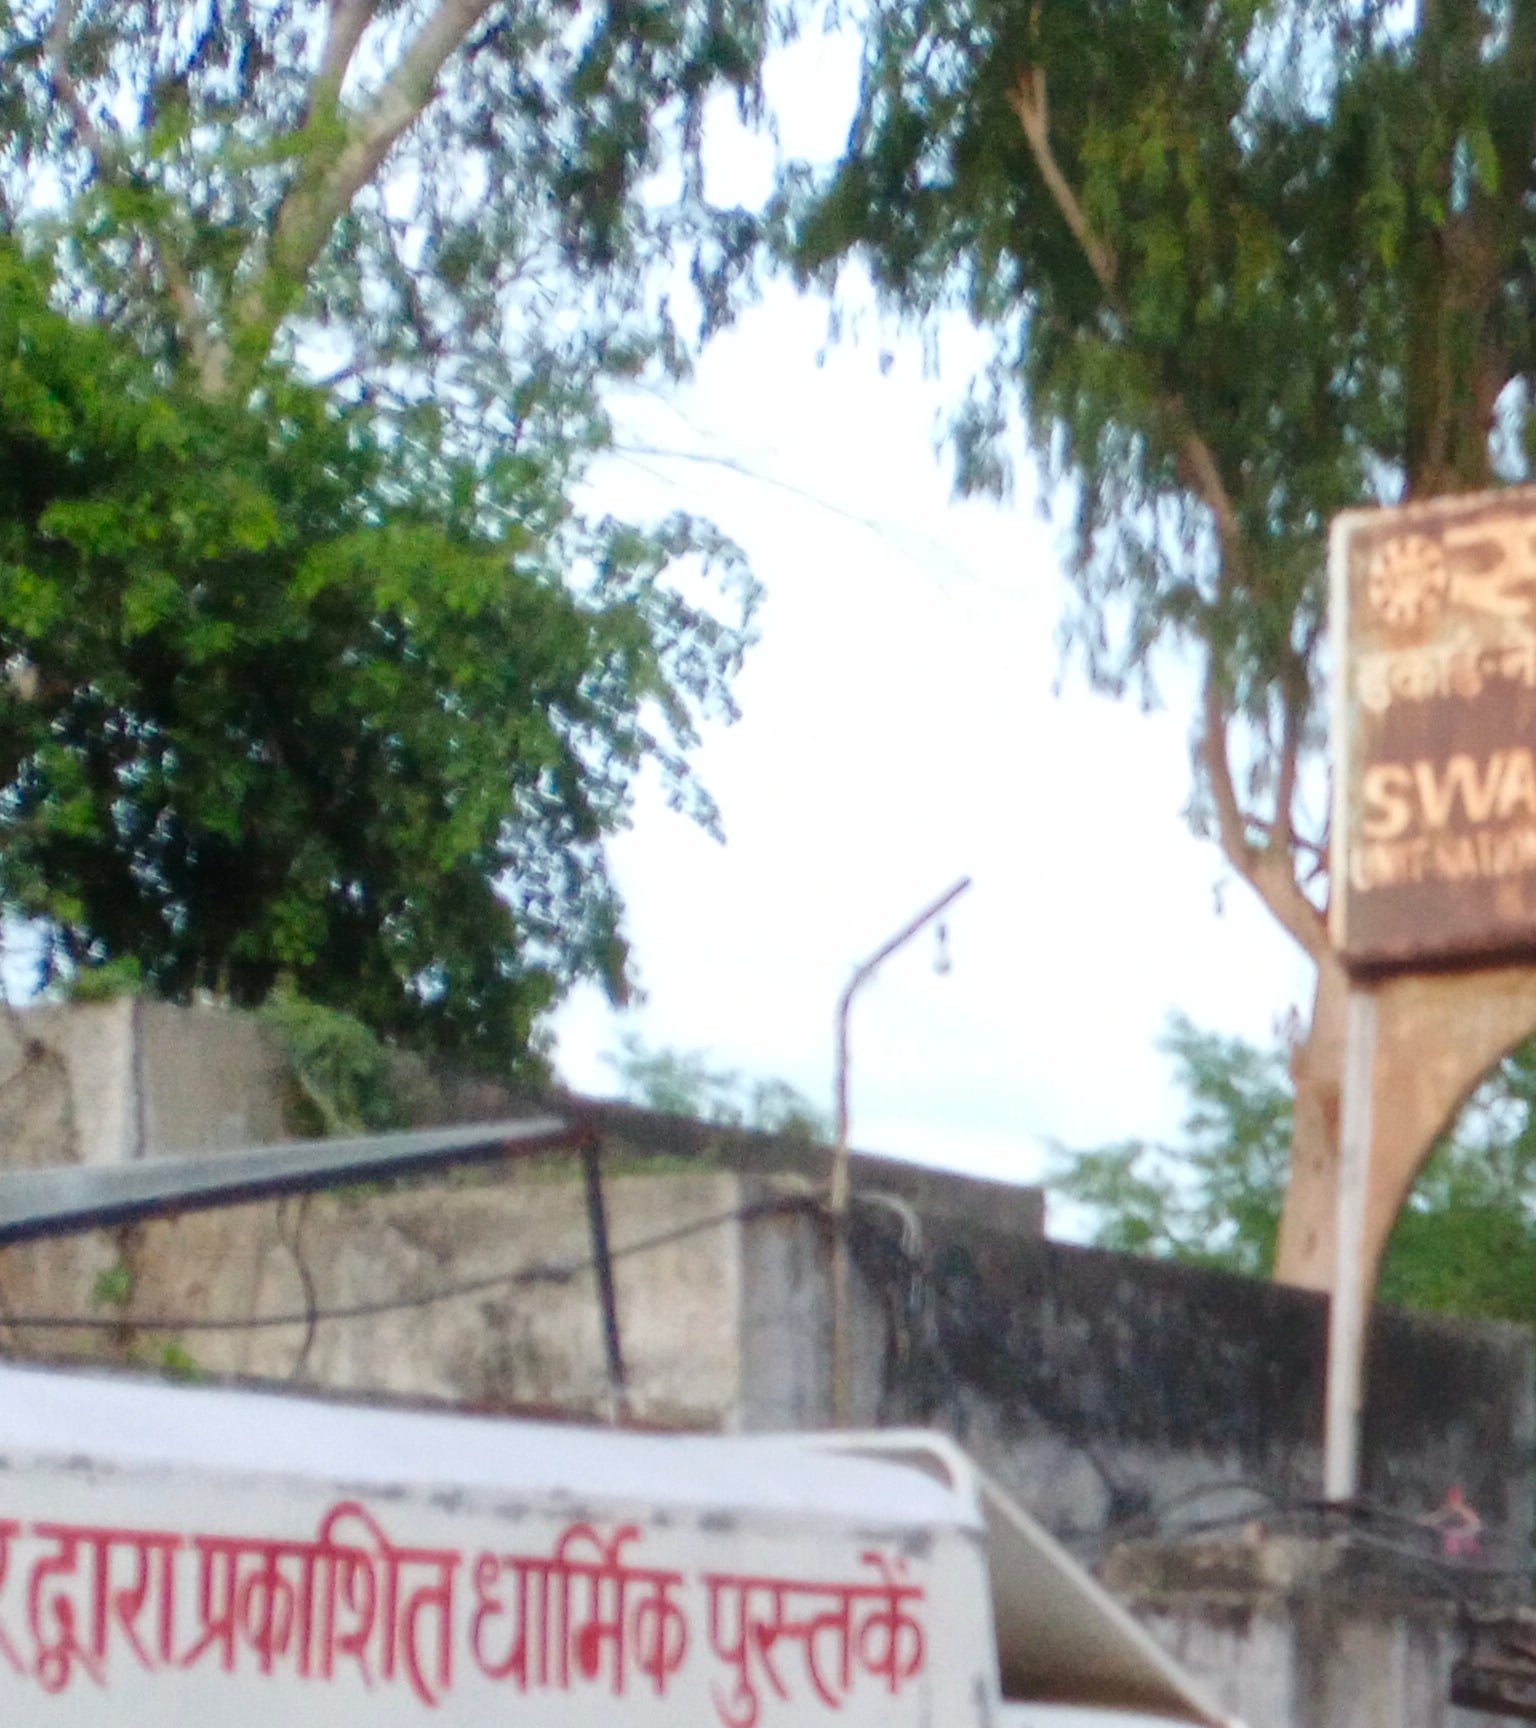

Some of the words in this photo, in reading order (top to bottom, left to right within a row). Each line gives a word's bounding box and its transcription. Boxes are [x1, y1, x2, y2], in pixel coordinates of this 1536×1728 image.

[27, 1522, 183, 1695] द्वारा
[181, 1500, 461, 1706] प्रकाशित
[472, 1523, 688, 1695] धार्मिक
